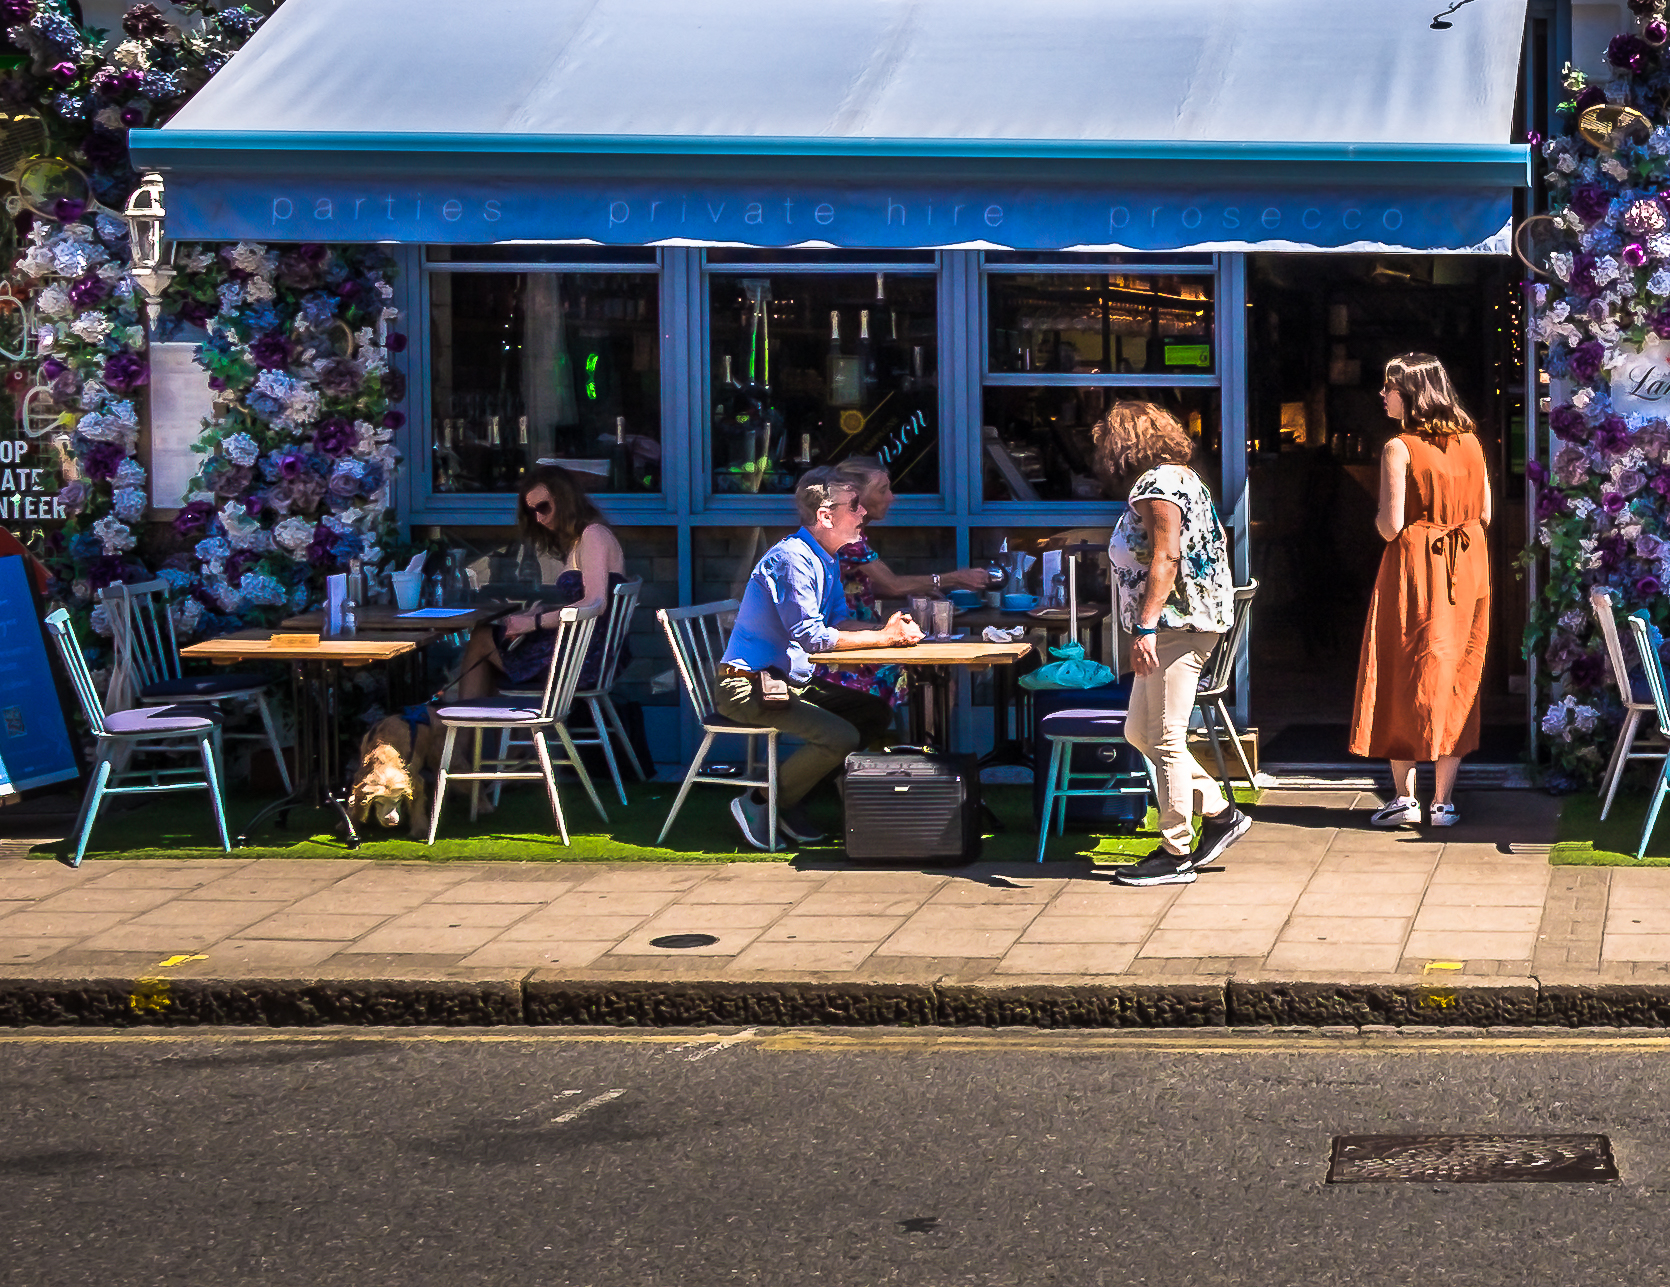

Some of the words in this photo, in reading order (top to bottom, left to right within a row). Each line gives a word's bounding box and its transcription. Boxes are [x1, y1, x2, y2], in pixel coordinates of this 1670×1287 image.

[271, 193, 502, 226] parties
[608, 195, 835, 229] private
[886, 196, 1005, 228] hire
[1109, 206, 1403, 235] prosecco
[875, 409, 928, 465] nson
